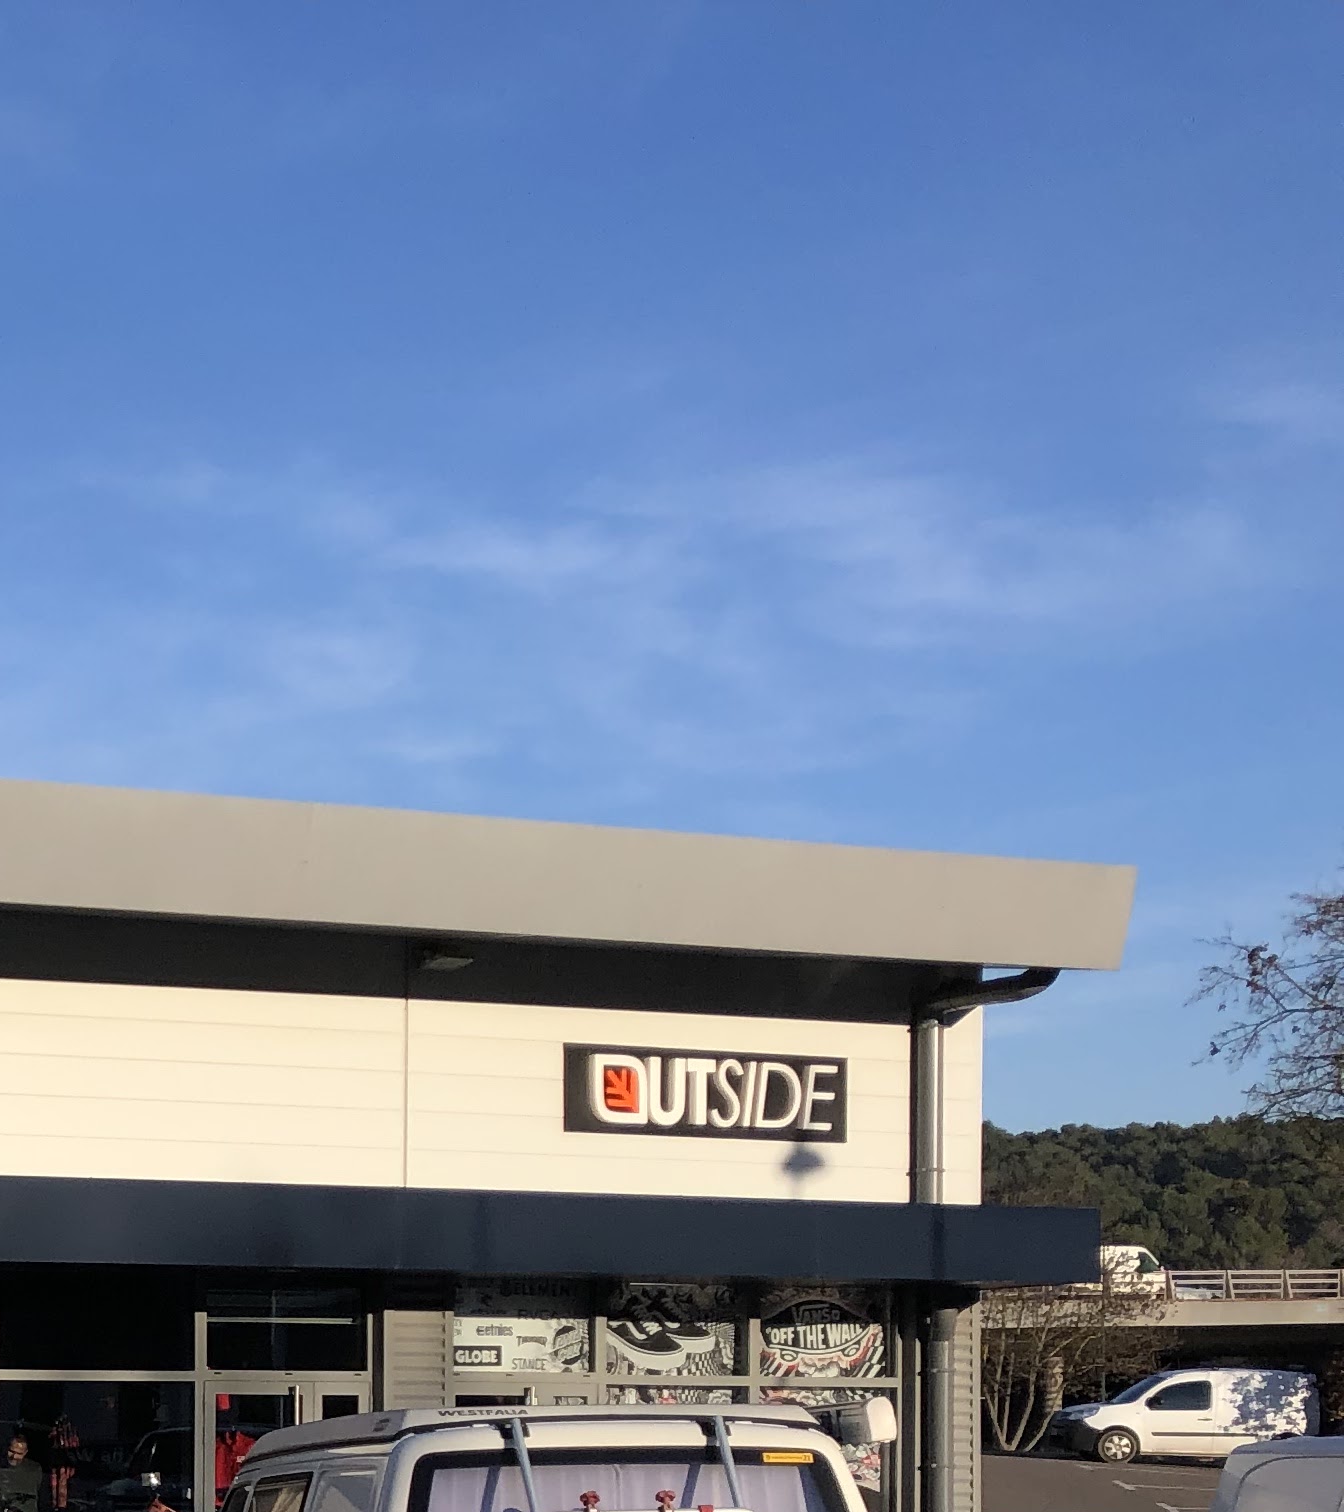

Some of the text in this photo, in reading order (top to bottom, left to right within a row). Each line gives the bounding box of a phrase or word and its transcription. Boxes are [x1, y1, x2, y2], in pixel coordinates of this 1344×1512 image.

[589, 1053, 839, 1131] OUTSIDE
[797, 1324, 826, 1349] THE
[455, 1349, 498, 1364] GLOBE
[512, 1358, 547, 1370] STANCE
[438, 1409, 528, 1417] WESTFALIA
